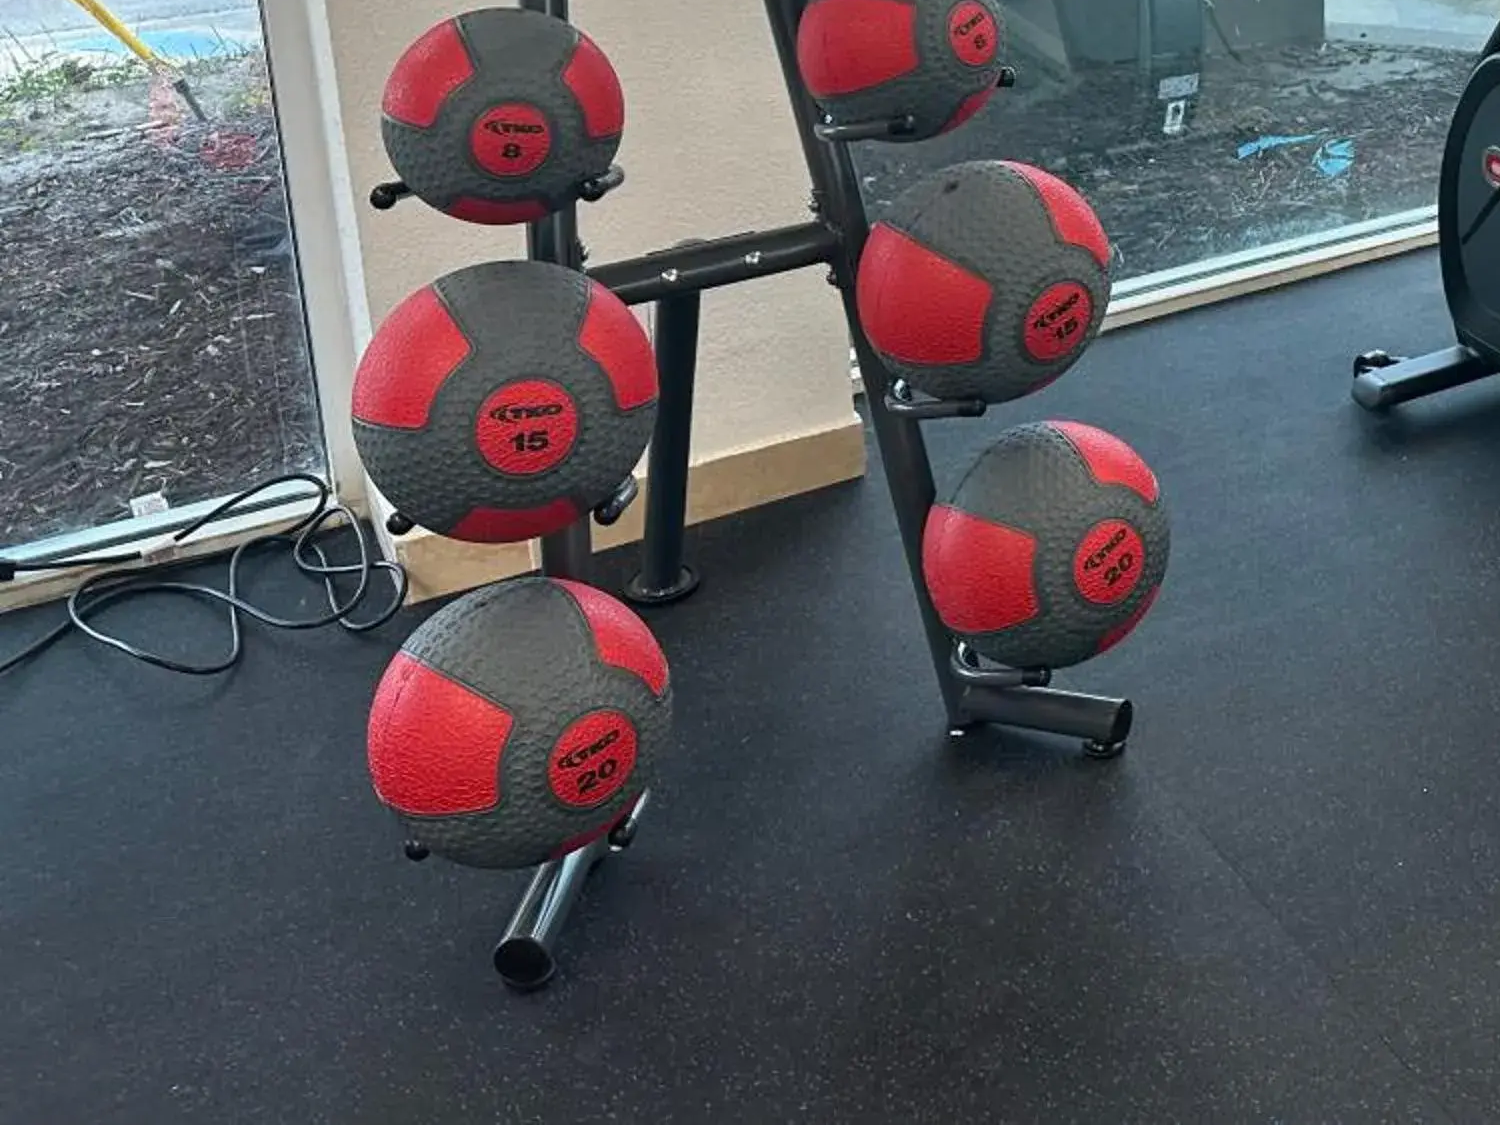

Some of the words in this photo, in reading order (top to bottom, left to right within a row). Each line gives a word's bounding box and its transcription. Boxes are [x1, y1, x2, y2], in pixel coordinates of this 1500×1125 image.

[502, 143, 521, 159] 8
[509, 431, 549, 451] 15
[1104, 554, 1133, 587] 20
[577, 759, 618, 794] 20
